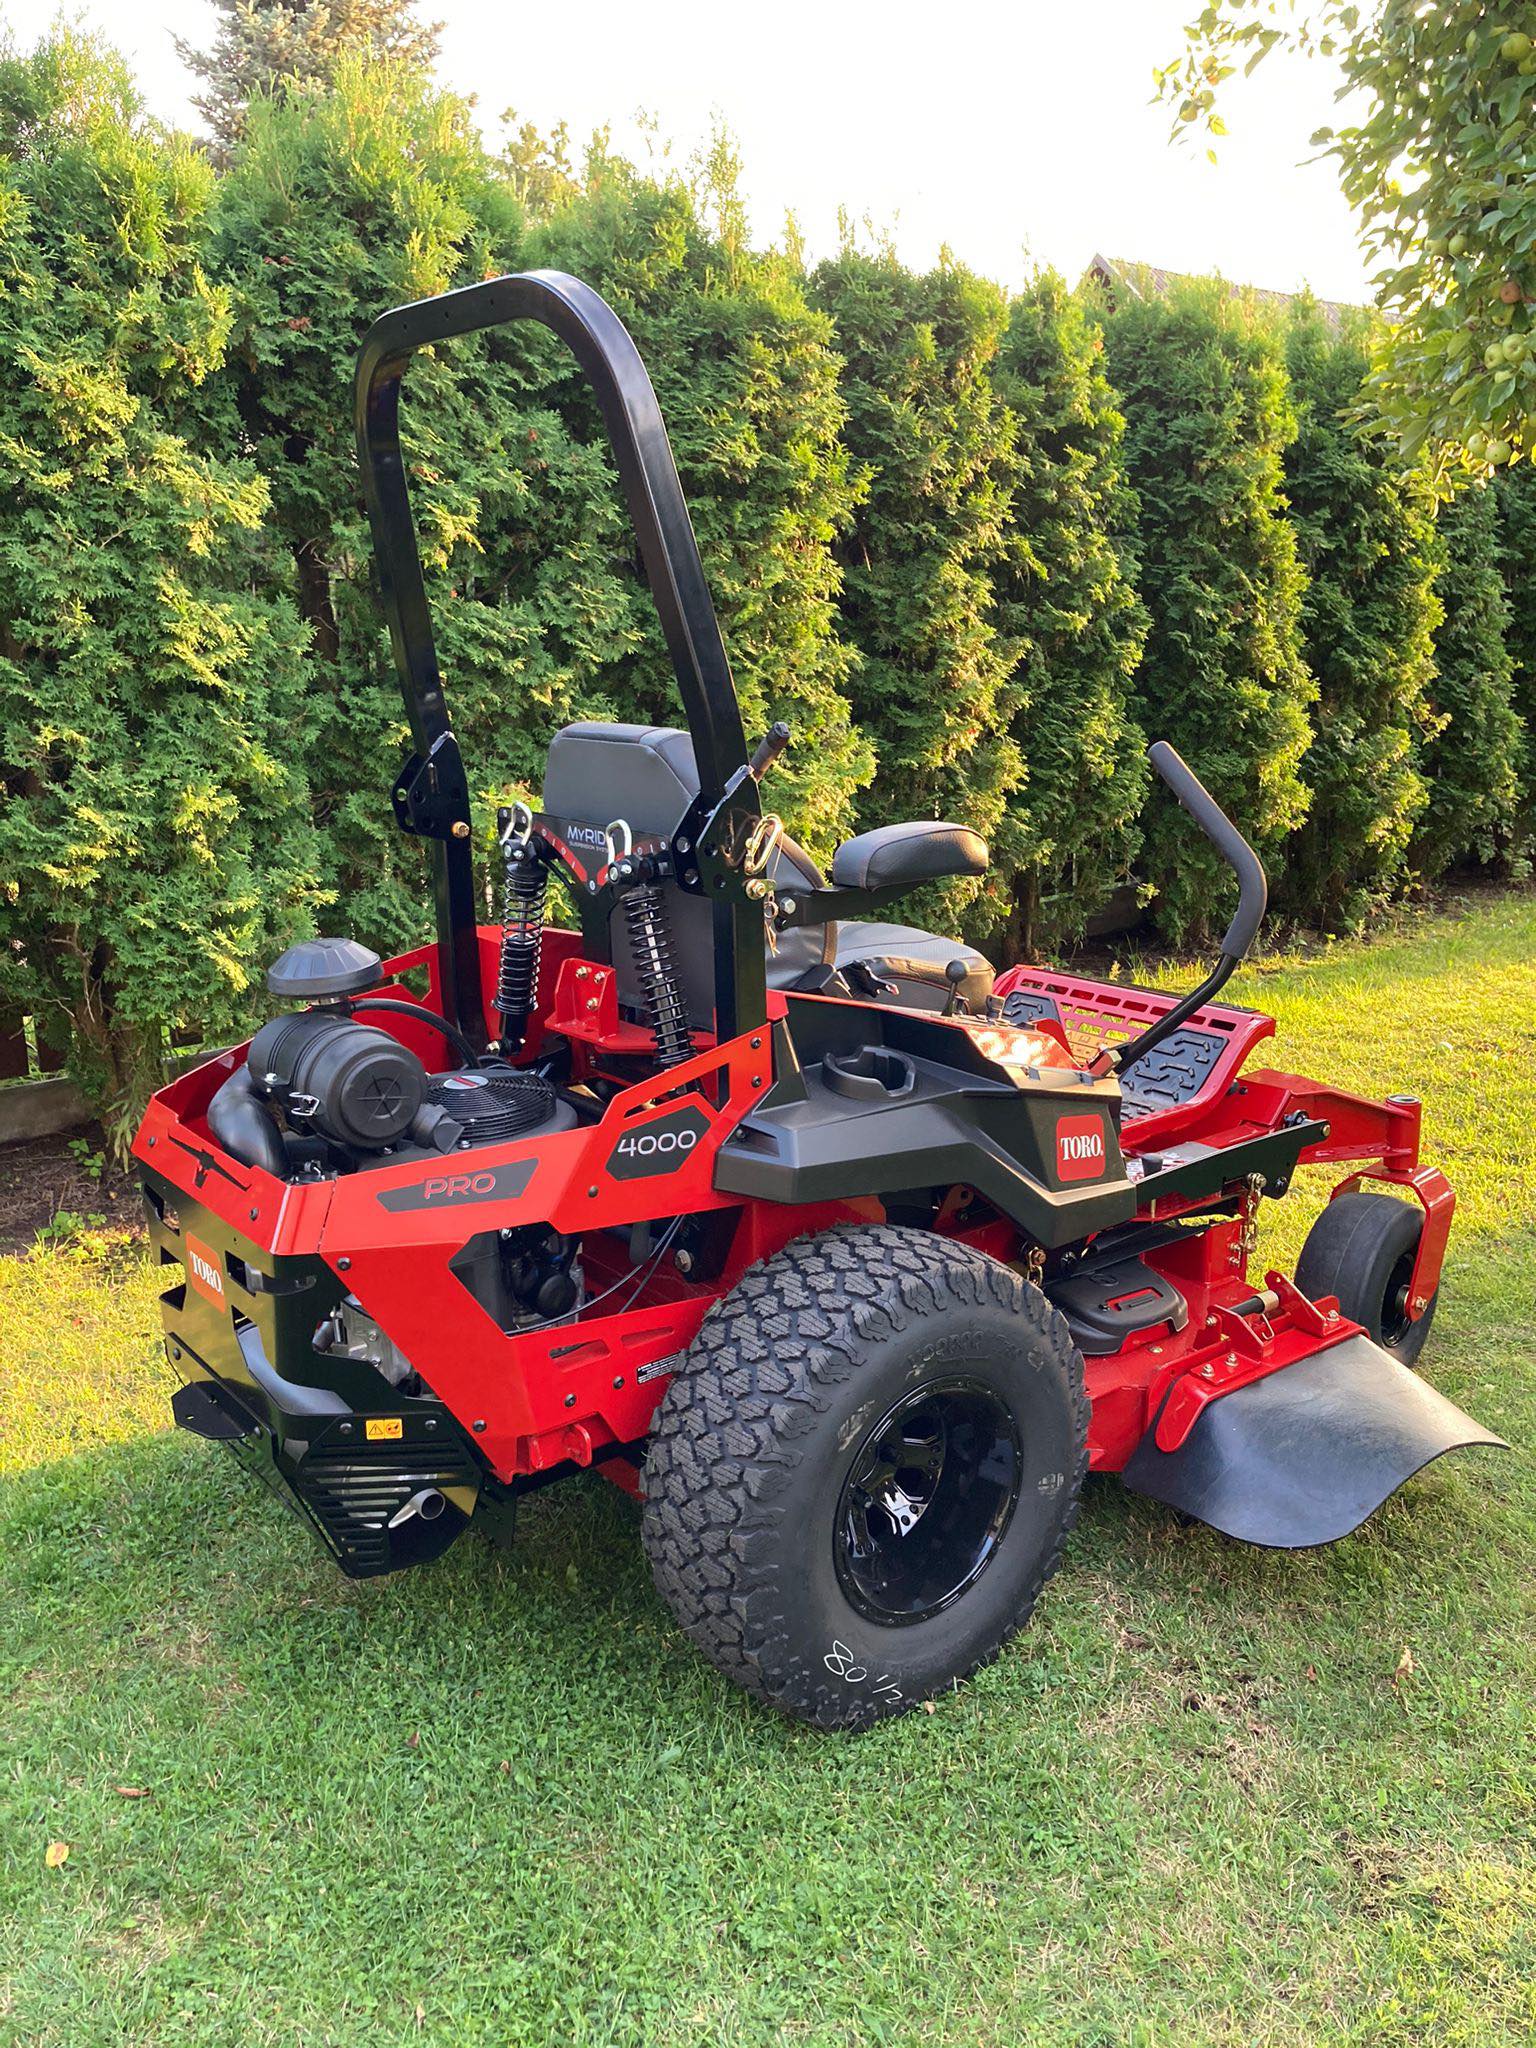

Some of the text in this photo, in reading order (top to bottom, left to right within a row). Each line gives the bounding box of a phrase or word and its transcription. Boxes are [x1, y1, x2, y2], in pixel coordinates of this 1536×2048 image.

[567, 825, 607, 846] MyRID
[617, 1129, 697, 1157] 4000
[1060, 1133, 1102, 1161] TORO
[424, 1173, 496, 1200] PRO
[189, 1250, 223, 1294] TORO
[823, 1639, 868, 1683] 80
